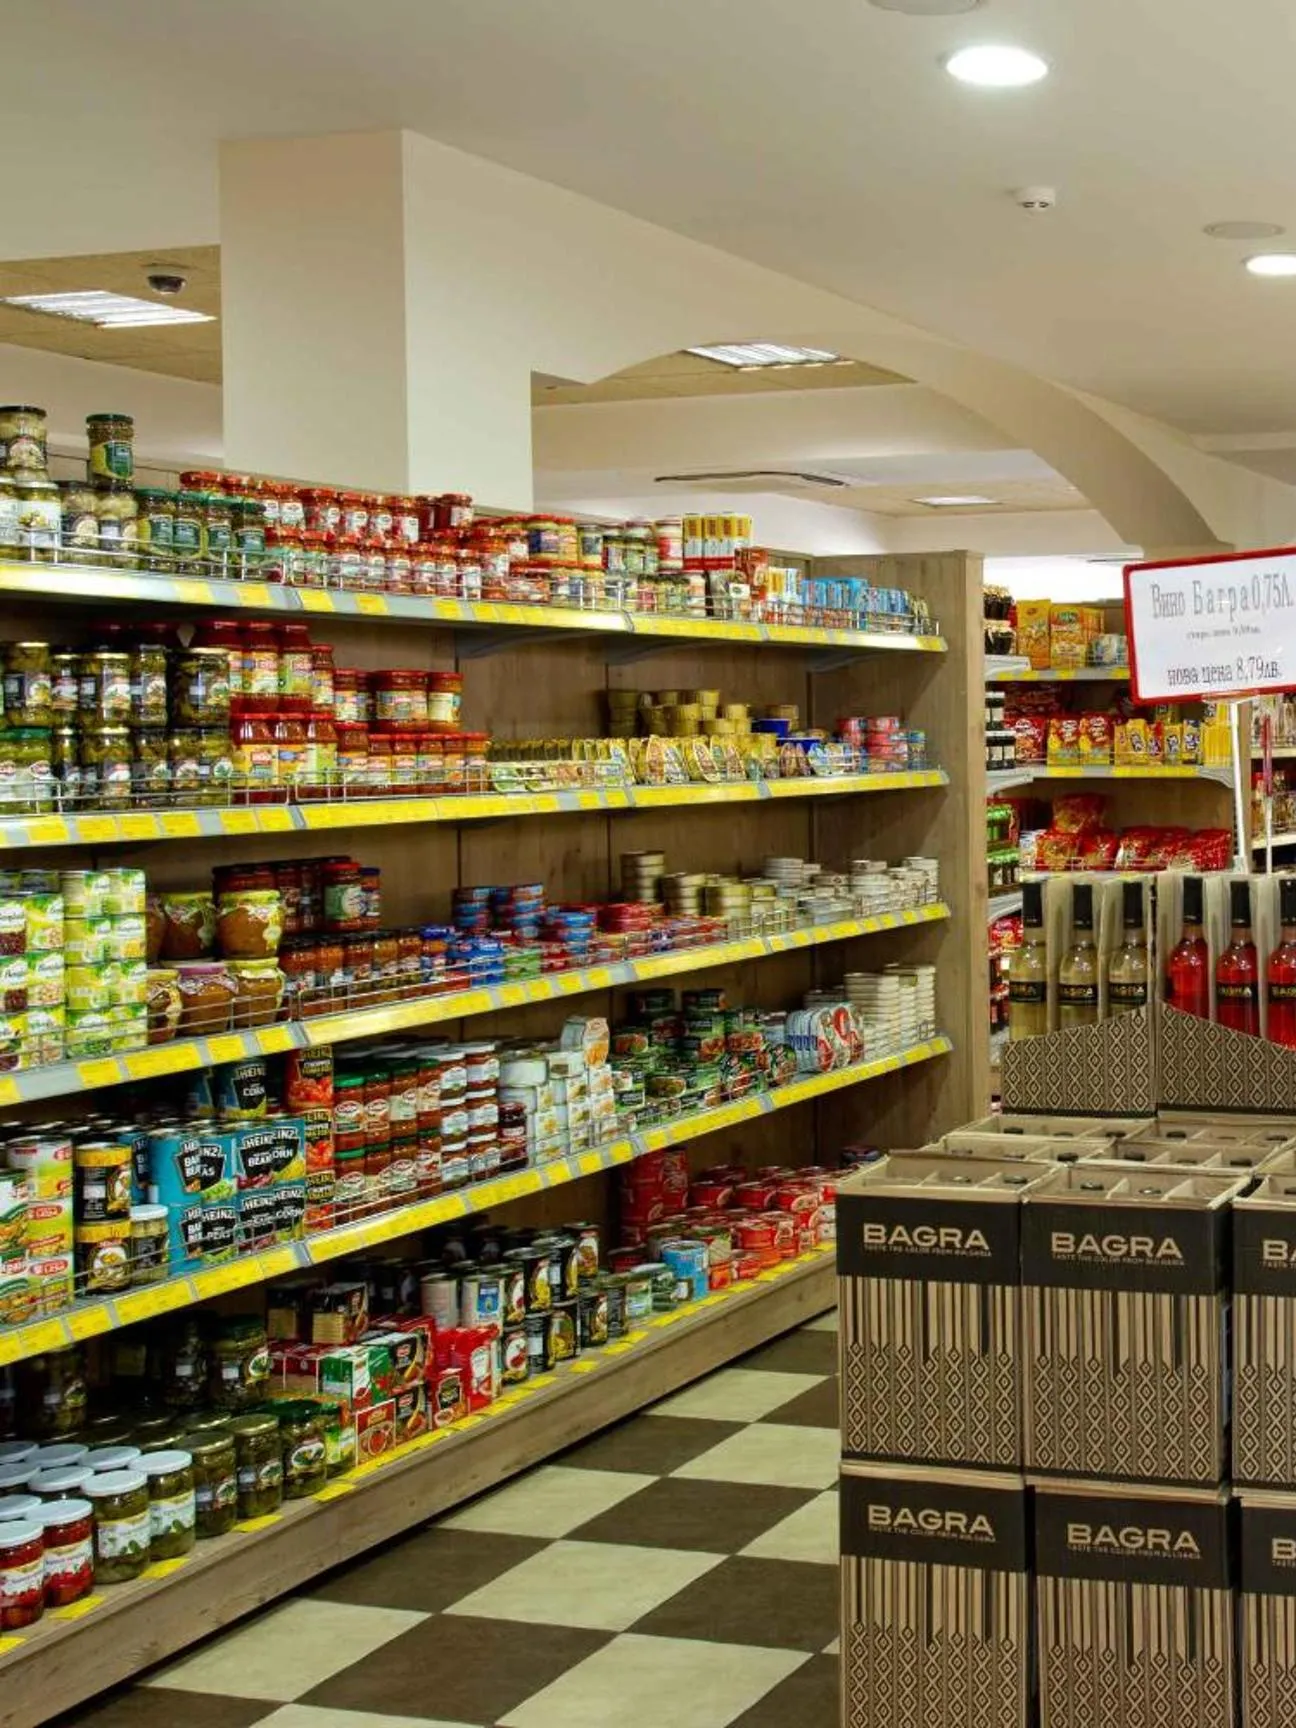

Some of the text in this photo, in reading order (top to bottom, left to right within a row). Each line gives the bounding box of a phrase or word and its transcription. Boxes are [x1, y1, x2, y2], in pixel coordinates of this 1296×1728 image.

[1151, 583, 1186, 618] Вино
[1167, 666, 1199, 686] нова
[1201, 665, 1233, 684] цена
[864, 1222, 990, 1250] BAGRA
[1051, 1232, 1183, 1259] BAGRA
[868, 1504, 995, 1537] BAGRA
[1067, 1523, 1201, 1553] BAGRA
